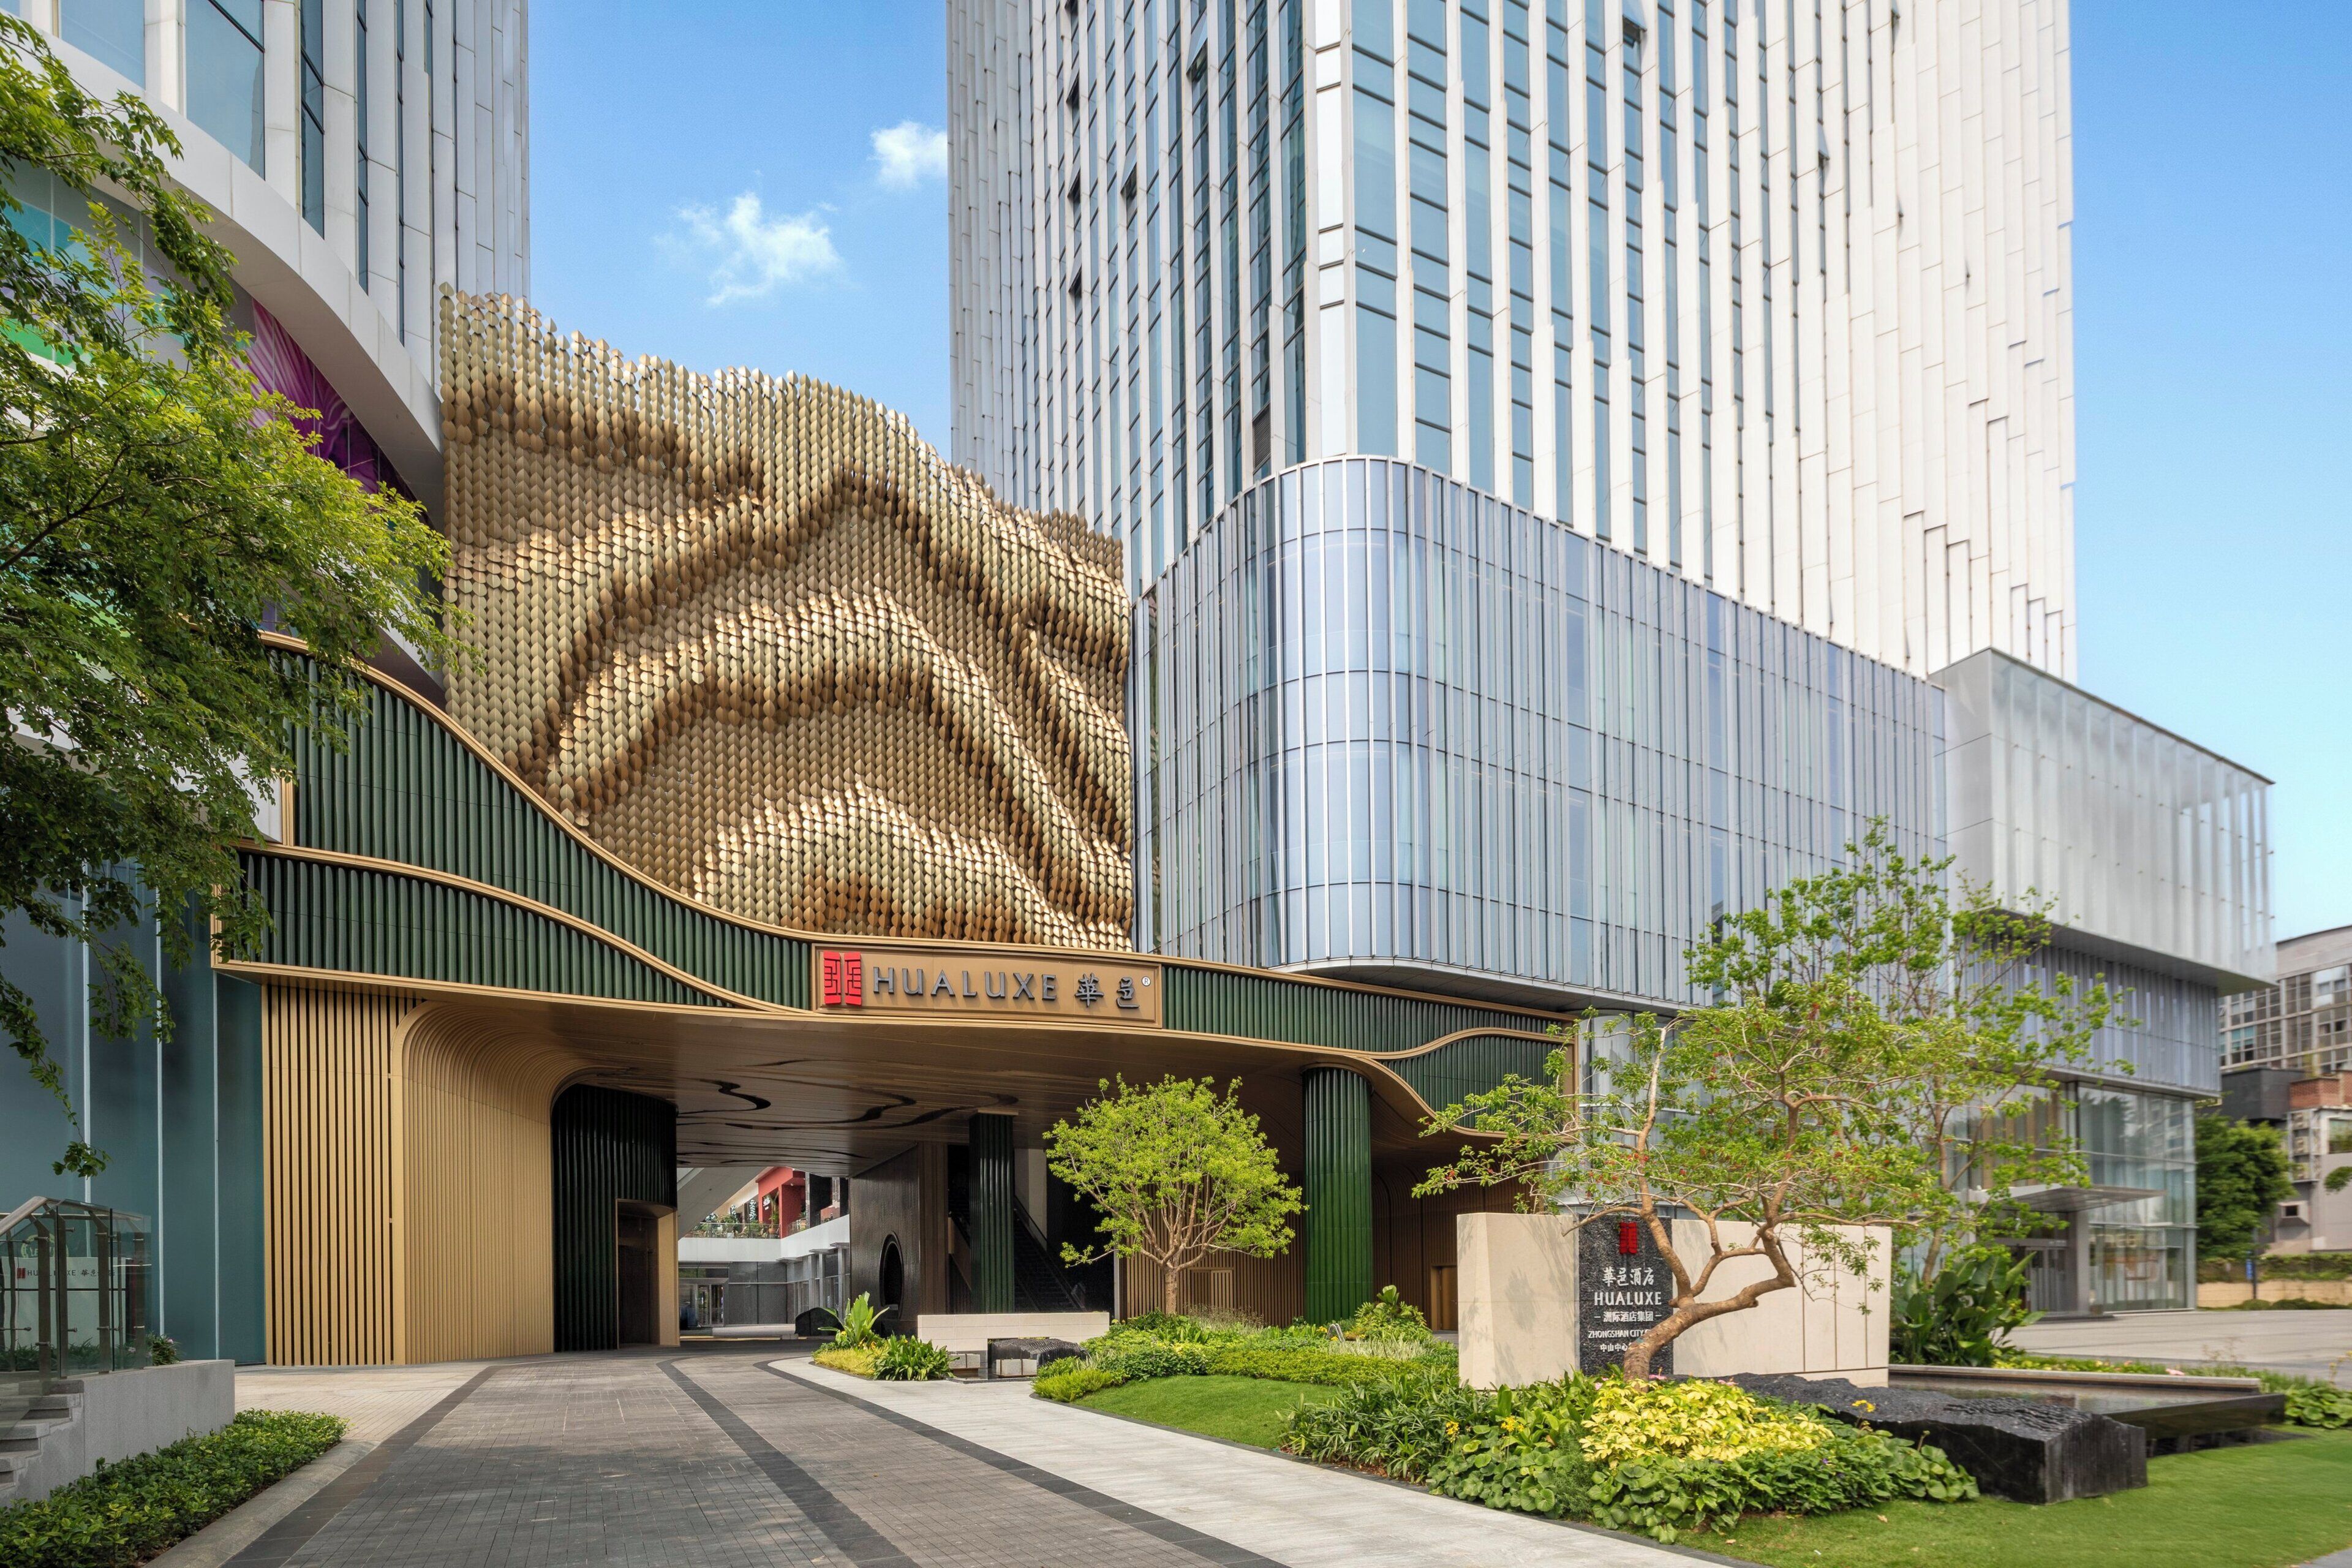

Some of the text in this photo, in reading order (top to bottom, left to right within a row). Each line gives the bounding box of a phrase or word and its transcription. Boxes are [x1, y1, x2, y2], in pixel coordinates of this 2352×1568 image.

[873, 967, 1057, 1001] HUALUXE
[1074, 972, 1140, 1008] 華邑
[1602, 1266, 1654, 1287] 華邑酒店
[1594, 1291, 1662, 1305] HUALUXE
[1603, 1311, 1654, 1322] 洲际酒店集团
[1588, 1330, 1629, 1338] ZHONGSHAN
